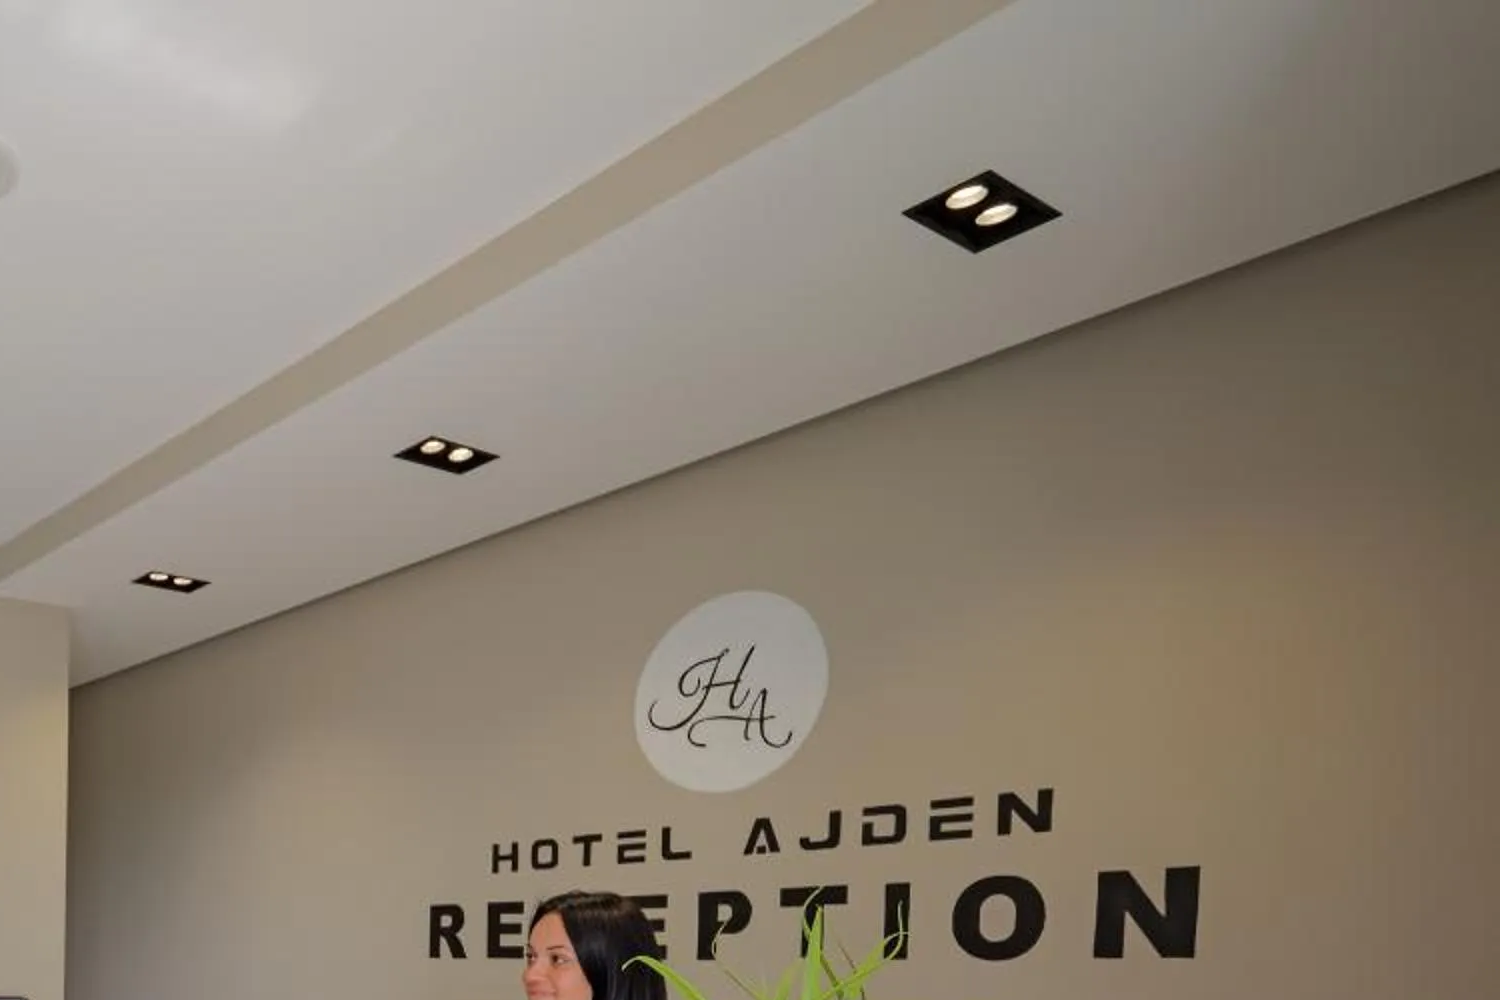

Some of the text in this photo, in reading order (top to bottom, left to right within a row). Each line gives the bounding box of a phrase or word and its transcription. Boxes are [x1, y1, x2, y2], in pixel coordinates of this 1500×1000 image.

[491, 786, 1054, 875] HOTEL AJDEN
[428, 864, 1201, 963] REPTION
